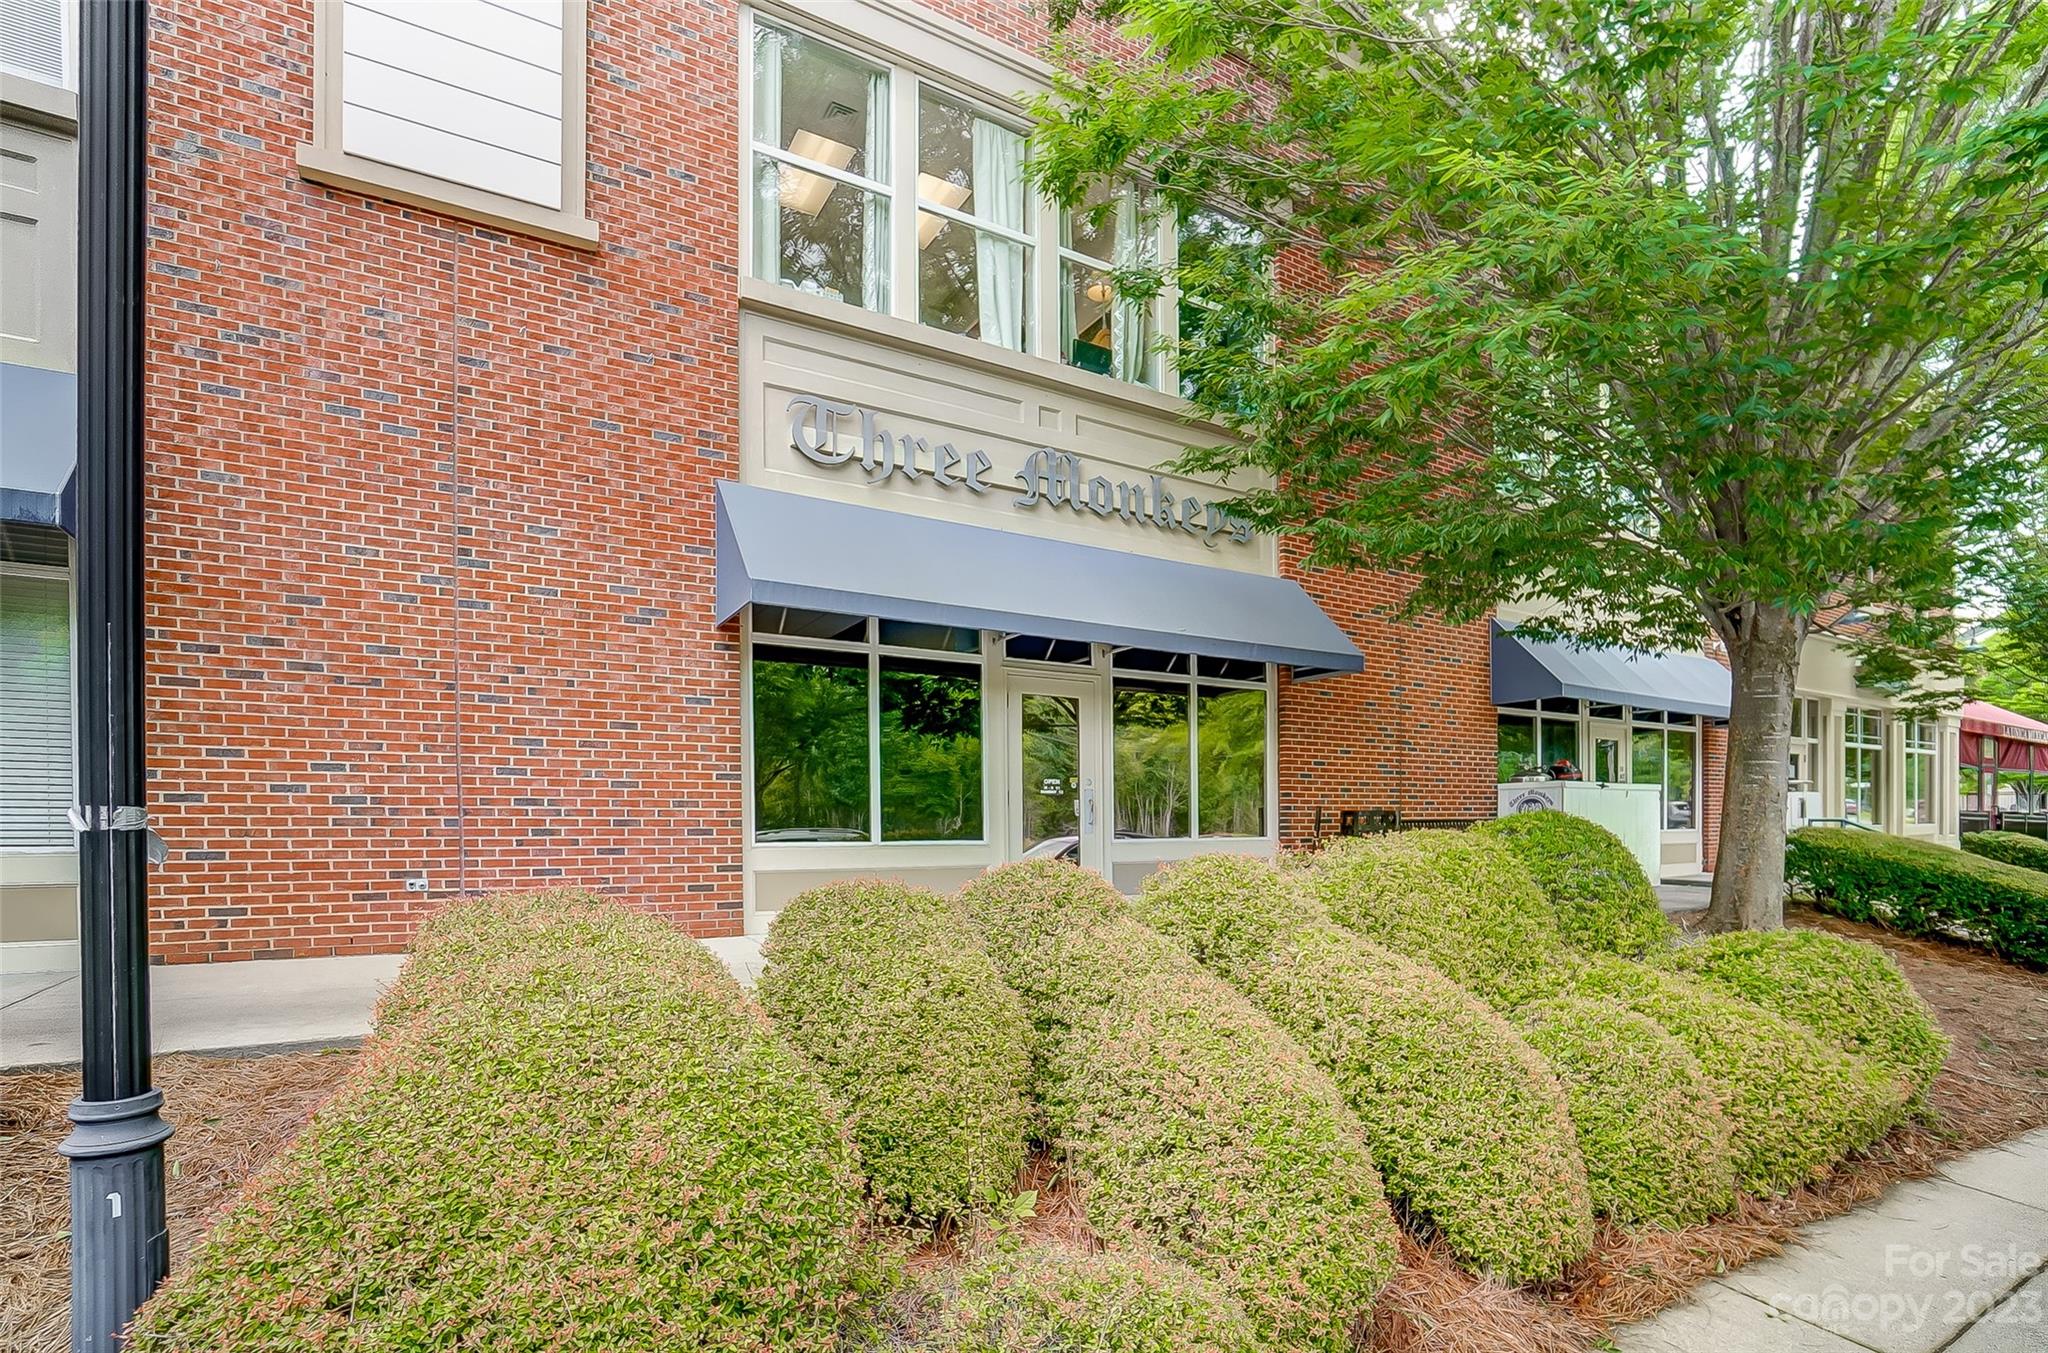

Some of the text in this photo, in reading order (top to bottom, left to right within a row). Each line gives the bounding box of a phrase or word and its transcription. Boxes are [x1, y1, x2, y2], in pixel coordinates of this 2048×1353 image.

[786, 394, 1254, 549] Three Monkeys
[105, 1192, 122, 1219] 1
